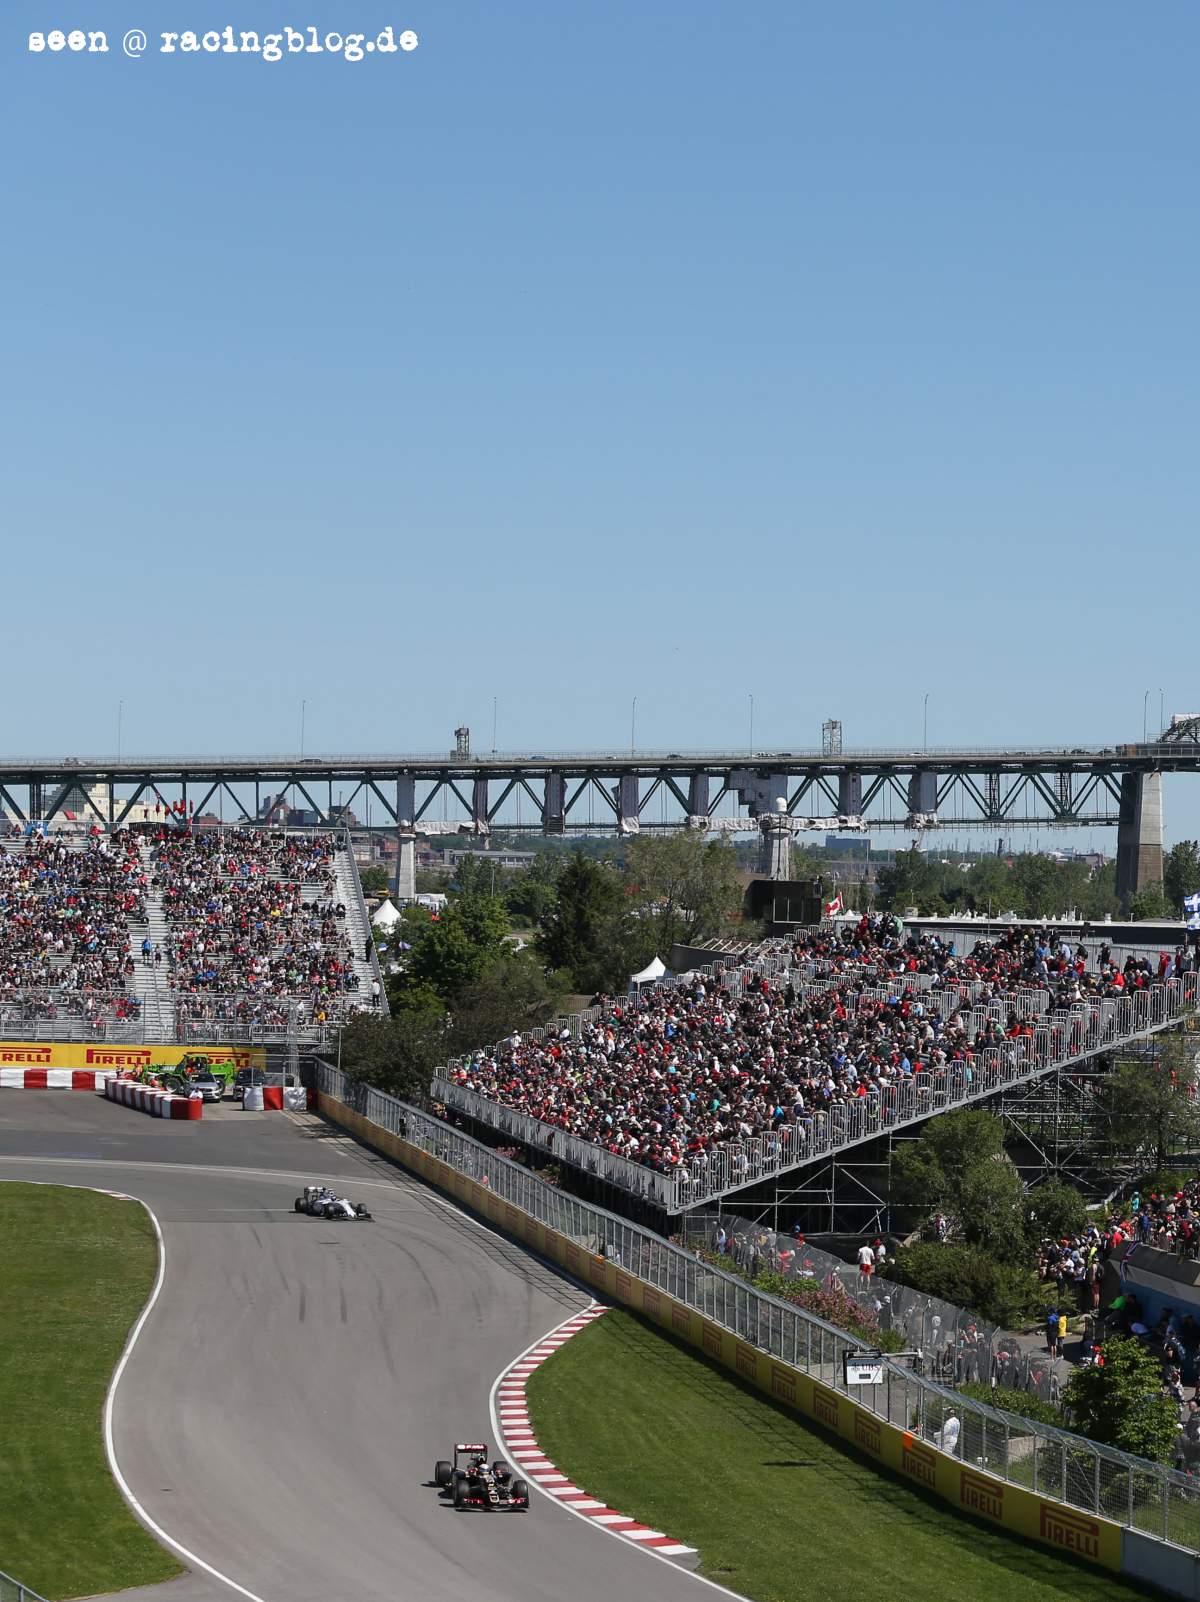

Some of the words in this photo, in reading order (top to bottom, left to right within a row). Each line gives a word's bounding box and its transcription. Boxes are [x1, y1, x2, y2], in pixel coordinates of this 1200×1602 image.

[0, 1046, 52, 1063] RELLI
[86, 1049, 152, 1065] PIRELLI
[771, 1365, 796, 1401] PIRELLI
[861, 1363, 880, 1371] UBS
[814, 1386, 838, 1427] PIRELLI
[854, 1409, 881, 1455] PIRELLI
[960, 1471, 1004, 1520] PIRELLI
[1040, 1504, 1100, 1557] PIRELLI
